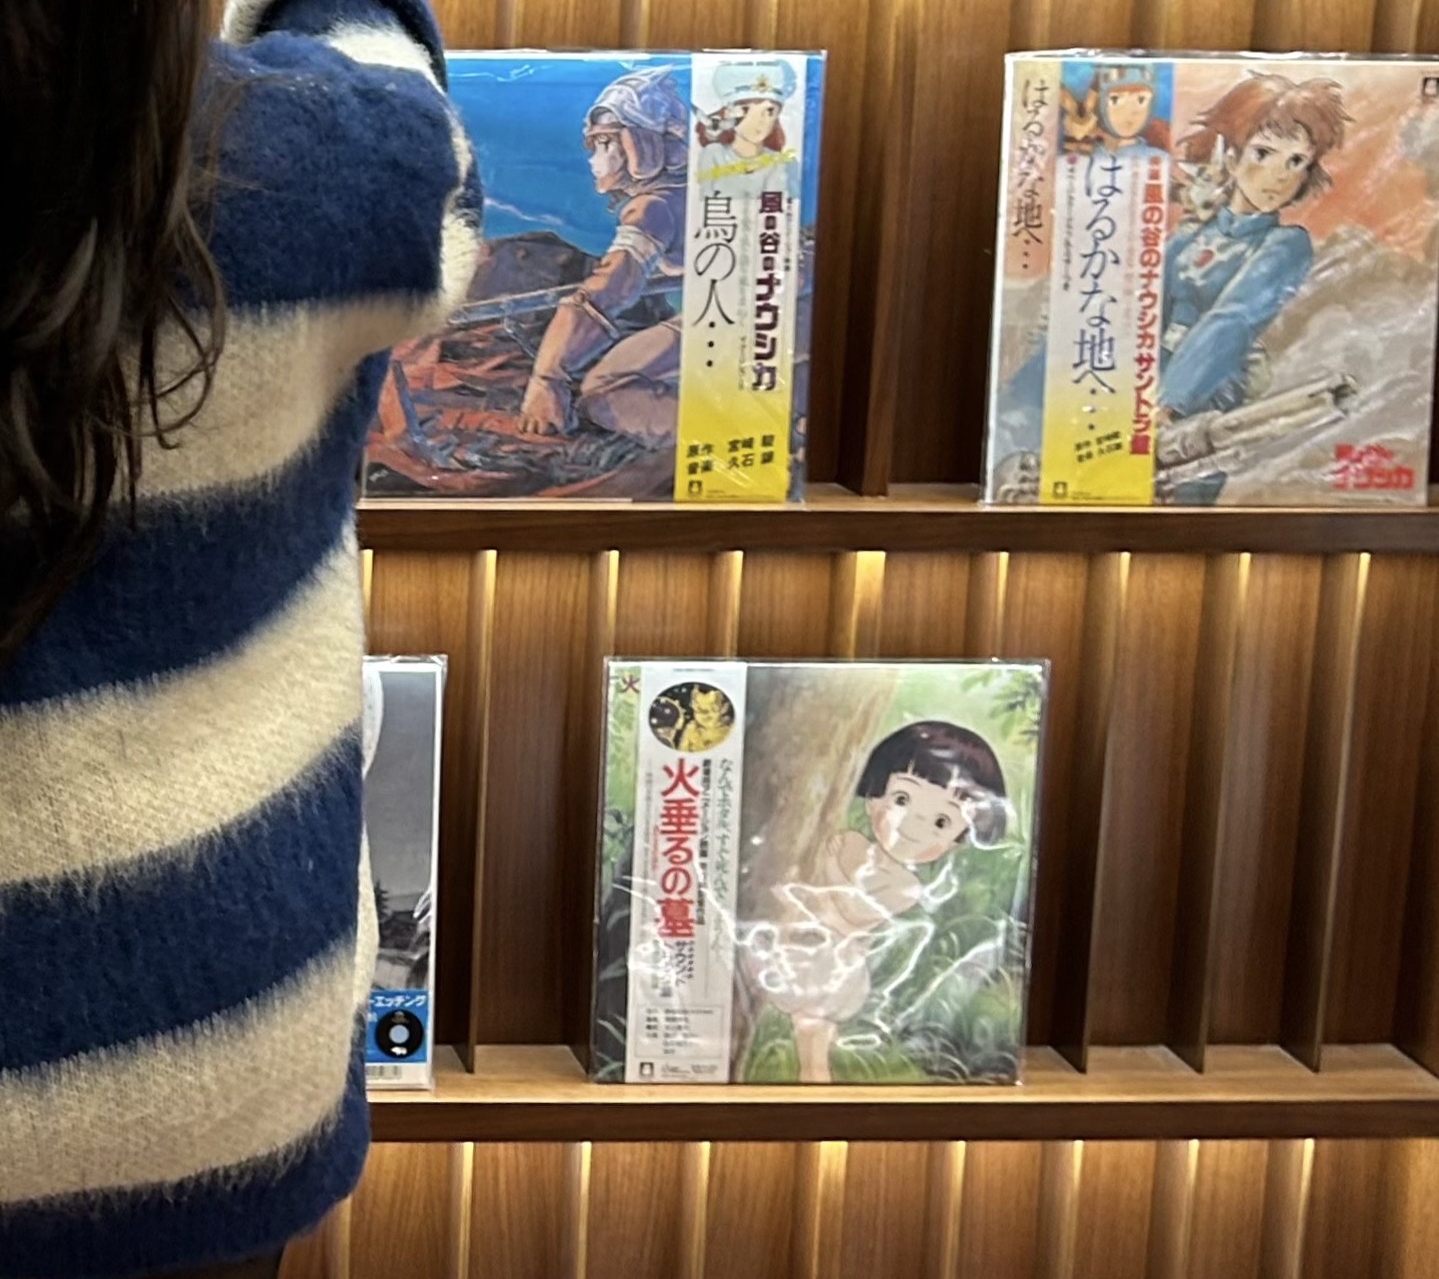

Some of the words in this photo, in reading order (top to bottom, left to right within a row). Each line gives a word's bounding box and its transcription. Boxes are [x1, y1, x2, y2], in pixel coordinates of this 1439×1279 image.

[622, 674, 641, 695] 火
[655, 757, 701, 938] 火垂るの墓
